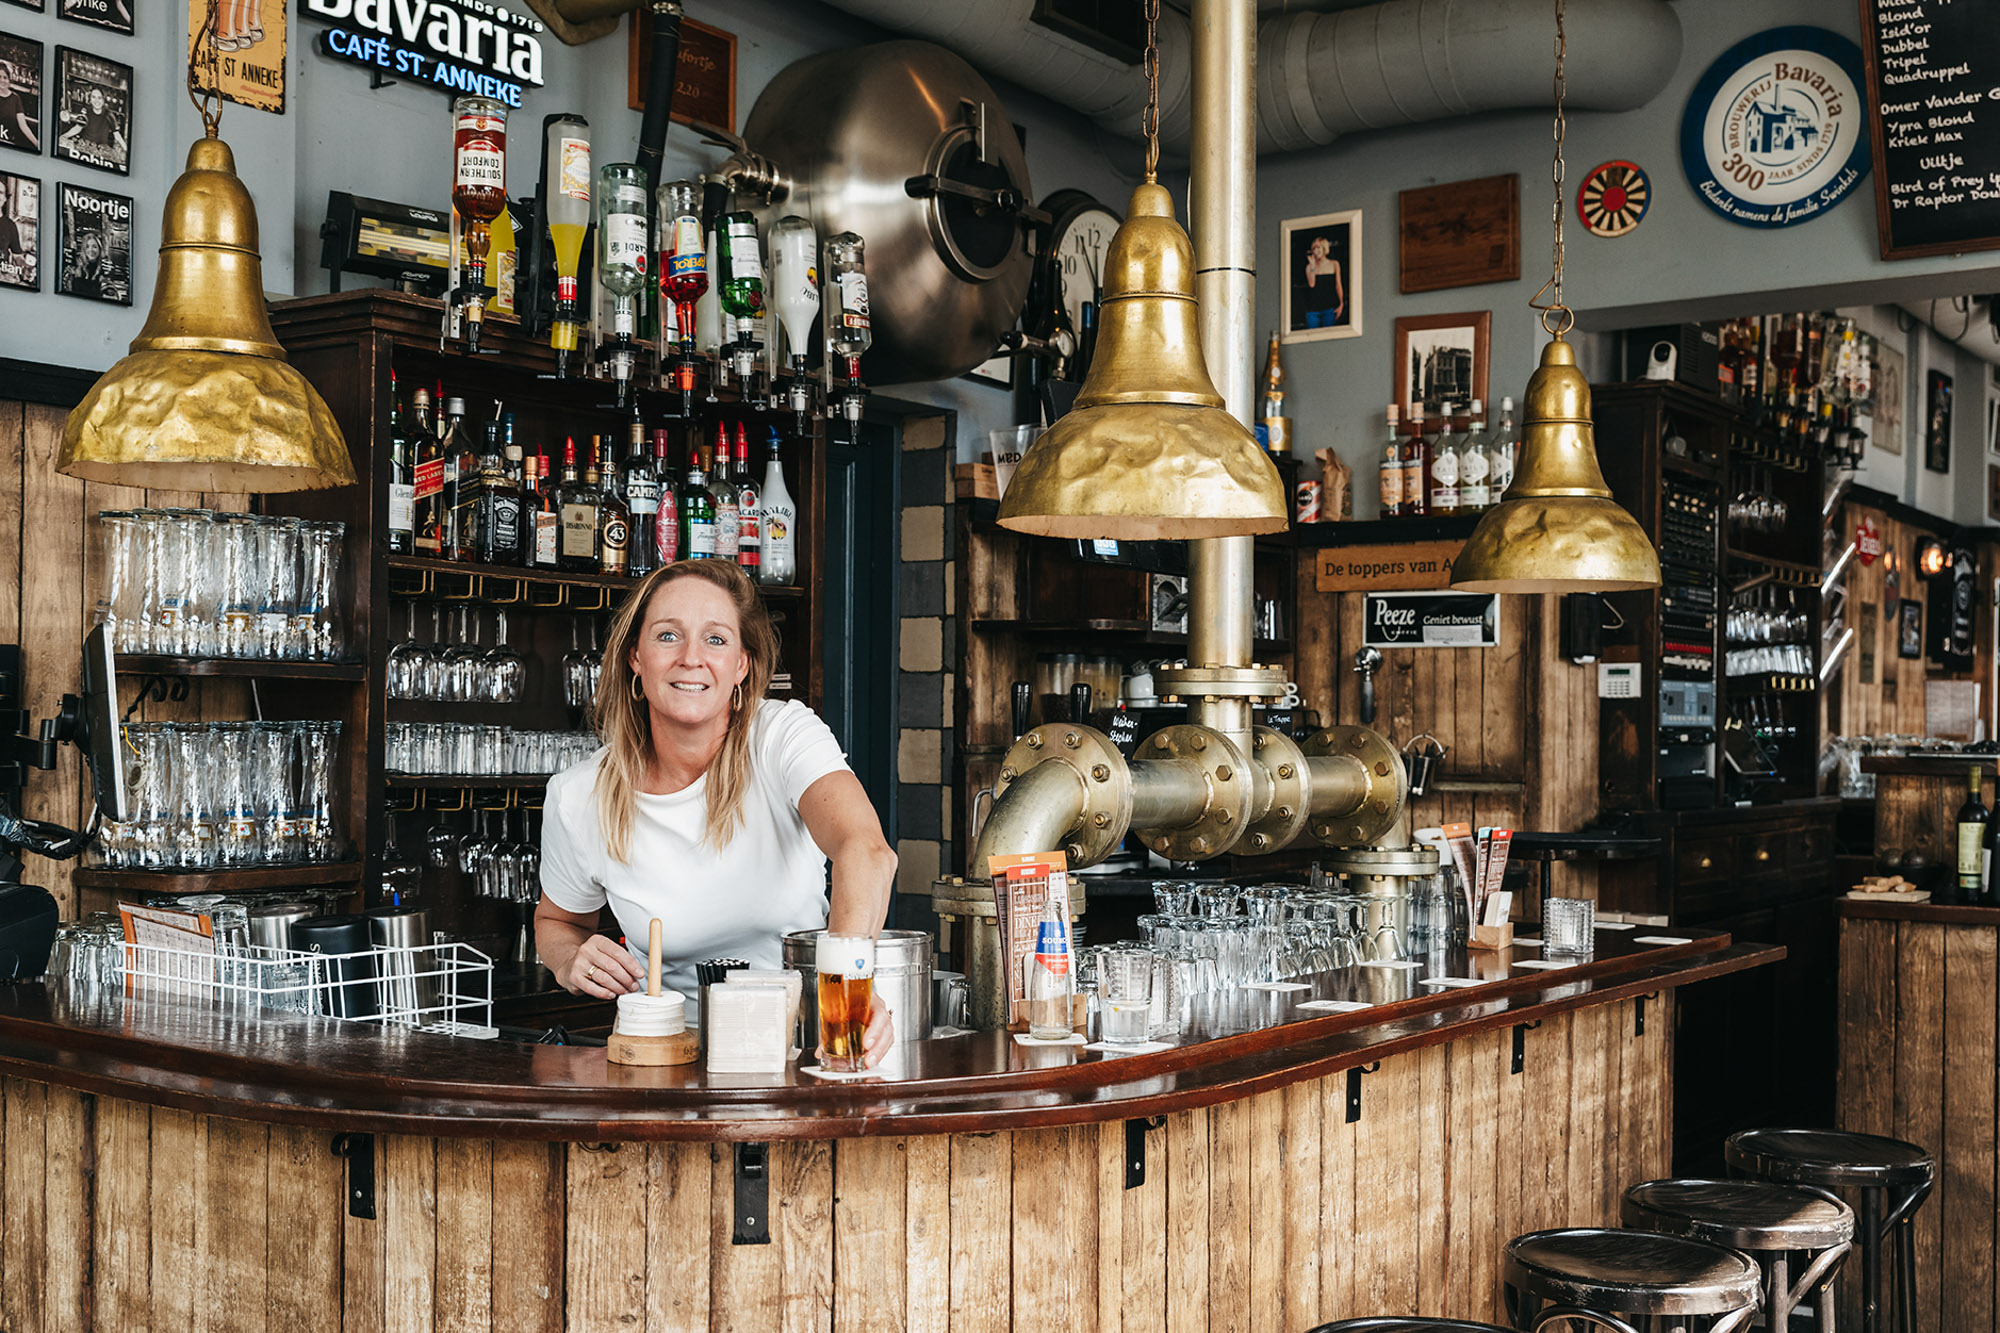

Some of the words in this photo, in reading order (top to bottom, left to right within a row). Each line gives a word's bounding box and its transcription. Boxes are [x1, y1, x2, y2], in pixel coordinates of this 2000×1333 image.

[511, 14, 543, 33] 1719
[1879, 6, 1924, 24] Blond
[1881, 23, 1932, 39] Isid'or
[306, 0, 545, 86] avaria
[1881, 37, 1930, 54] Dubbel
[223, 56, 237, 77] ST
[241, 61, 279, 89] ANNEKE
[328, 29, 391, 67] CAFÉ
[395, 49, 428, 79] ST.
[433, 62, 522, 108] ANNEKE
[1882, 53, 1928, 72] Tripel
[1884, 61, 1971, 85] Quadruppel
[1774, 62, 1842, 118] Bavaria
[1880, 101, 1921, 115] Omer
[1924, 91, 1983, 109] Vander
[1729, 80, 1772, 149] BROUWERIJ
[1887, 121, 1924, 138] Ypra
[1928, 110, 1976, 129] Blond
[1888, 134, 1929, 148] Kriek
[1934, 132, 1964, 143] Max
[462, 155, 500, 168] COMFORT
[1721, 152, 1765, 191] 300
[1767, 168, 1794, 179] JAAR
[1796, 145, 1824, 172] SINDS
[1819, 122, 1834, 145] 1719
[1920, 152, 1965, 171] Uiltje
[459, 167, 502, 180] SOUTHERN
[1890, 179, 1924, 194] Bird
[1928, 175, 1946, 191] of
[1951, 176, 1985, 190] Prey
[64, 188, 129, 220] Noortje
[1731, 206, 1770, 223] namens
[1770, 206, 1784, 222] de
[1783, 198, 1820, 224] familie
[1819, 167, 1859, 207] Swinkels
[1892, 198, 1910, 209] Dr
[1914, 192, 1965, 210] Raptor
[1087, 228, 1101, 249] 12
[672, 255, 706, 270] APEROL
[1064, 254, 1077, 276] 10
[608, 527, 625, 540] 43
[1325, 562, 1344, 576] De
[1348, 562, 1405, 578] toppers
[1409, 561, 1437, 572] van
[1374, 599, 1416, 626] Peeze
[1423, 615, 1450, 625] Geniet
[1451, 614, 1483, 625] bewust
